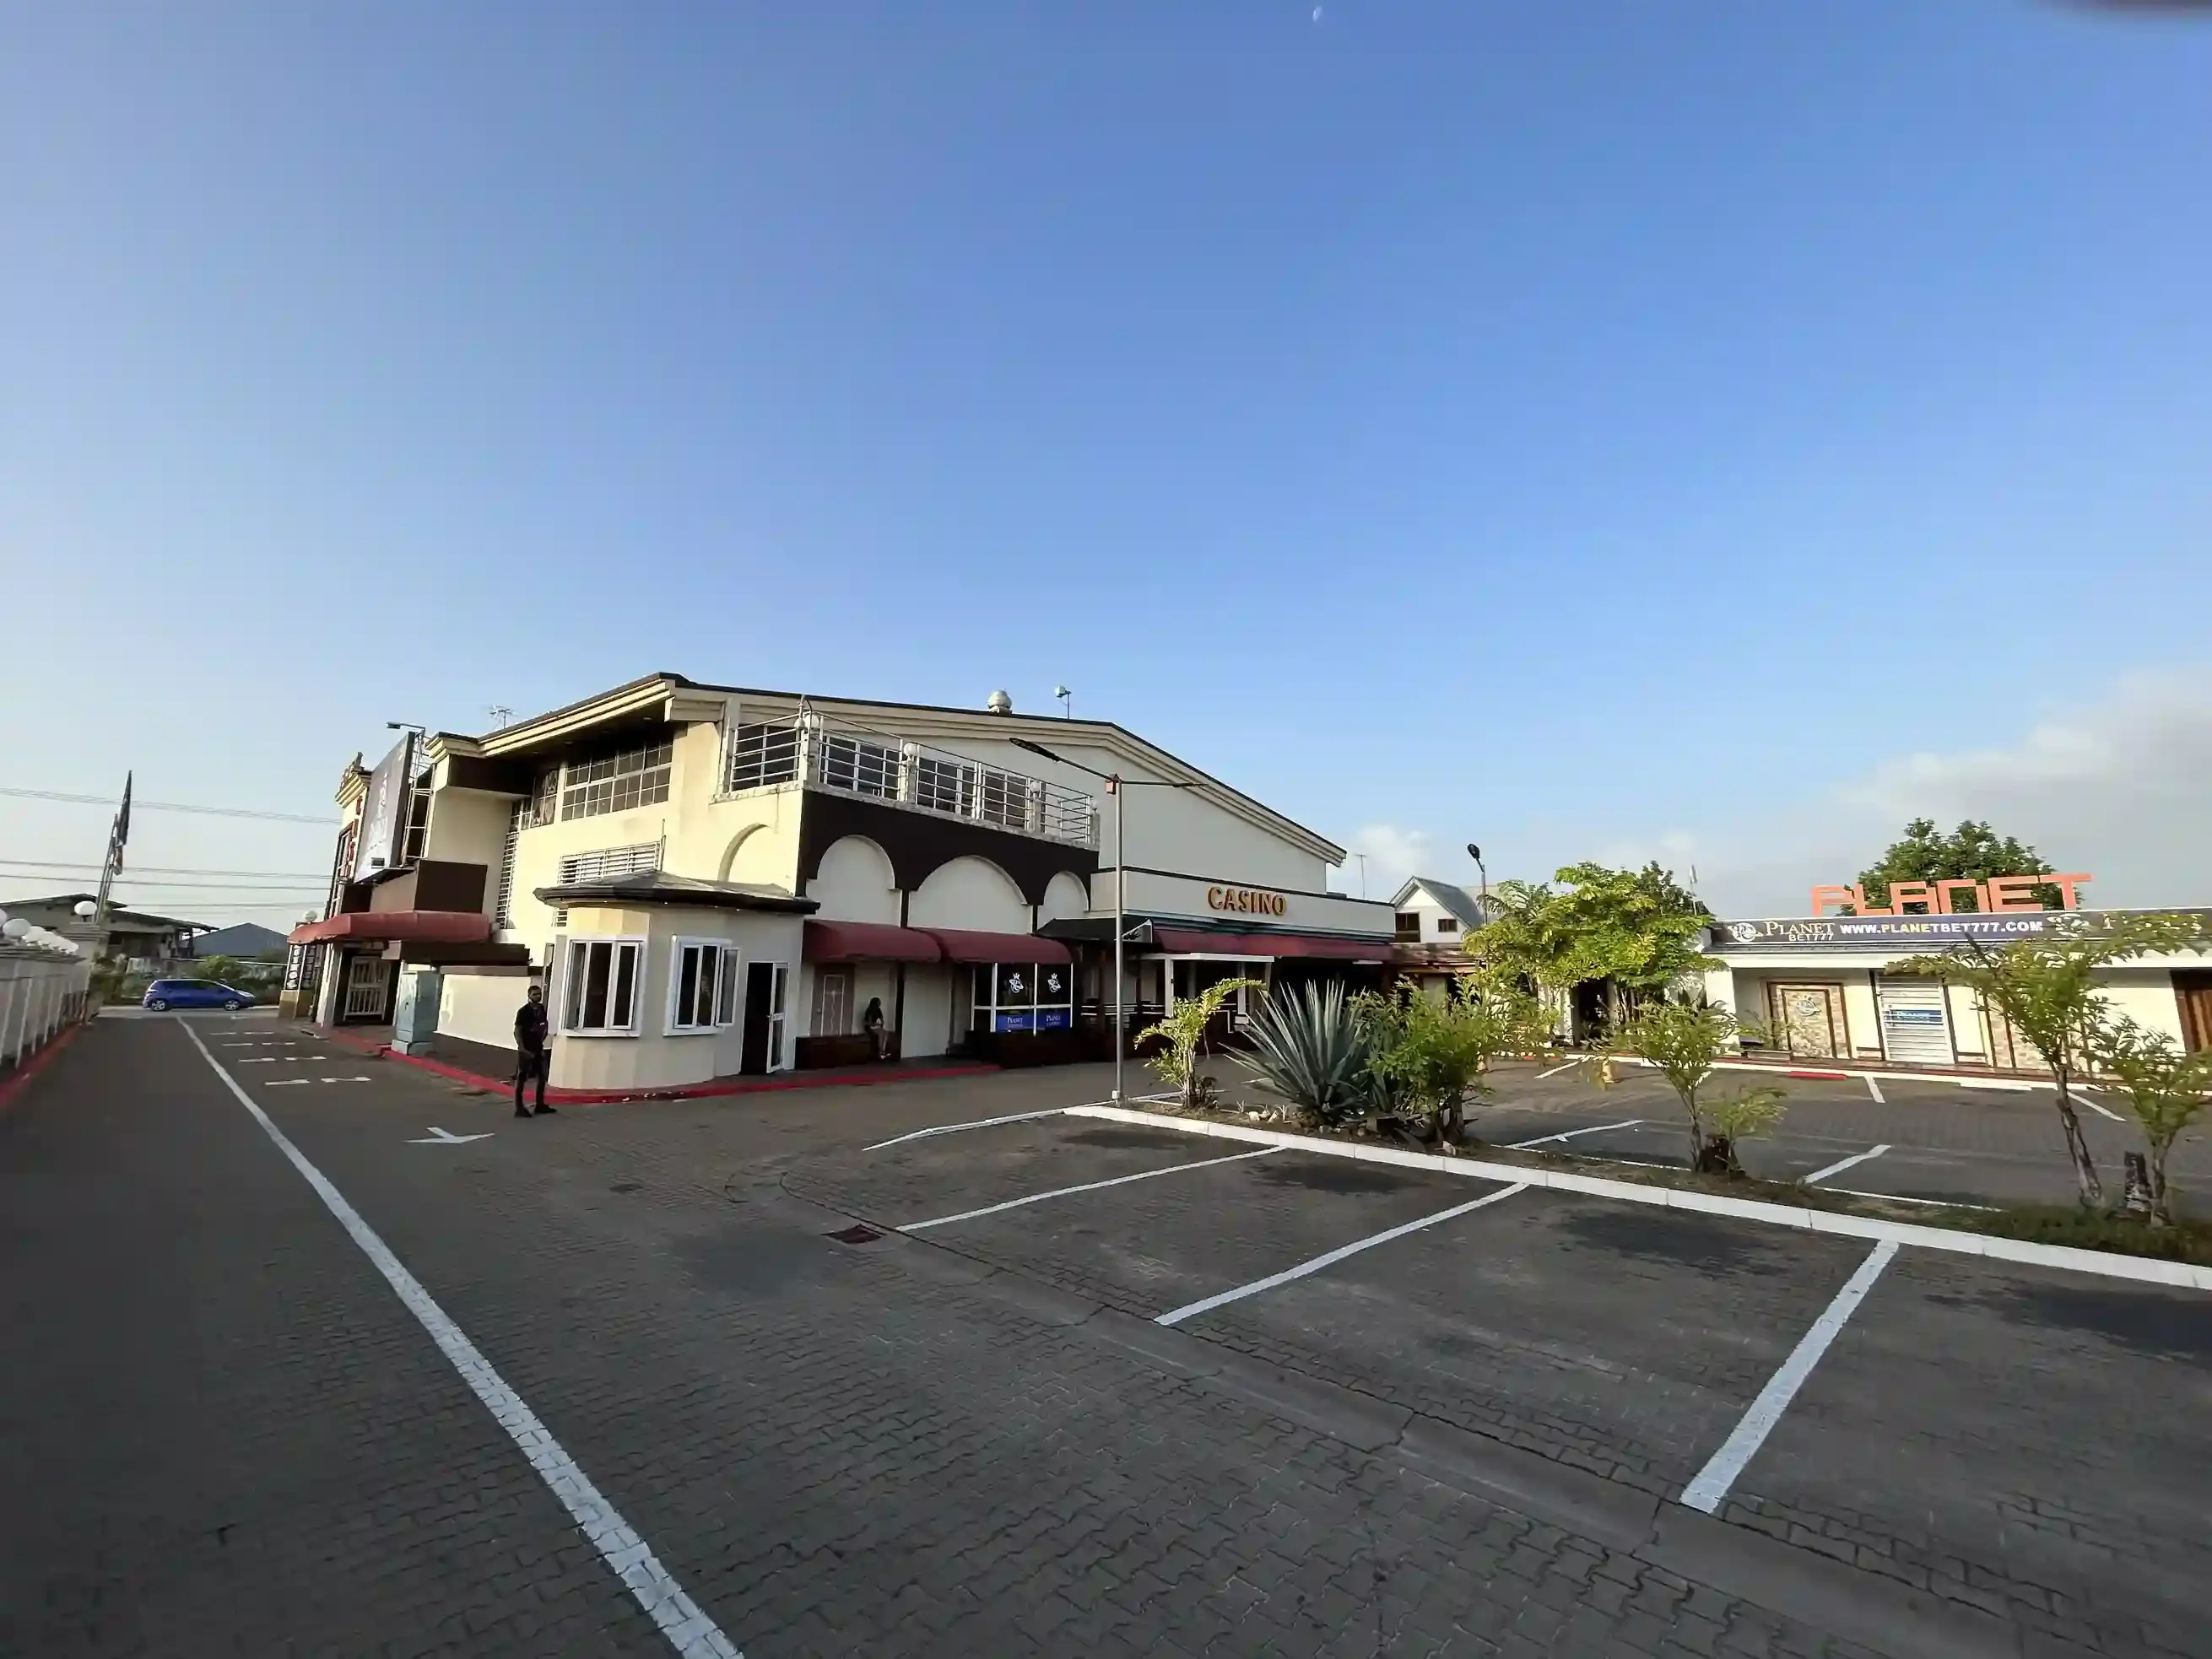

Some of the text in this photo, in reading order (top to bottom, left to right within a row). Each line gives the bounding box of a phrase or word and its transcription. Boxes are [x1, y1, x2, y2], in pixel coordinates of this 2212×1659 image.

[1208, 886, 1287, 916] CASINO
[1810, 873, 2095, 916] PLANET
[1763, 921, 1835, 937] PLANET
[1840, 921, 2043, 934] WWW.PLANETBET777.COM
[1788, 932, 1834, 942] BET777
